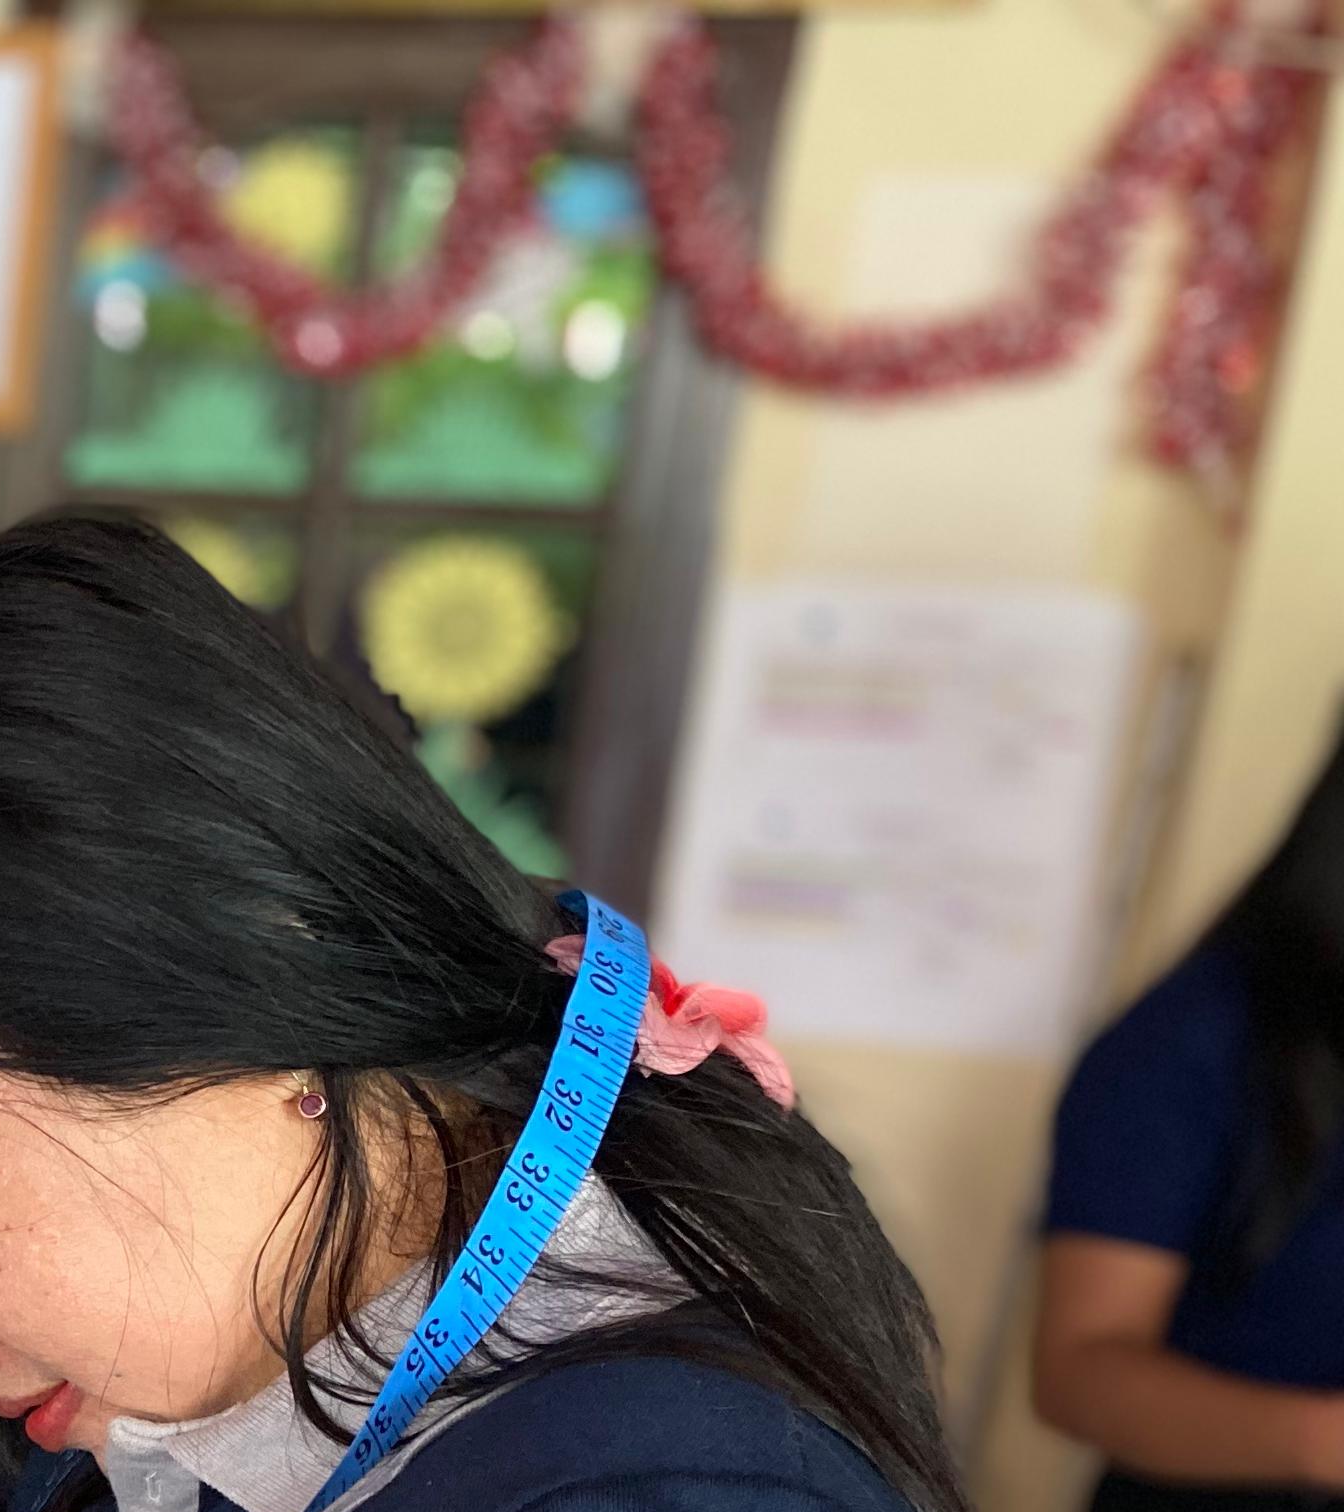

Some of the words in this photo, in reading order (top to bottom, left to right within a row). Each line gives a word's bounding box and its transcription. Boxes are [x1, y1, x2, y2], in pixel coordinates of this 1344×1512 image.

[589, 951, 624, 996] 30
[569, 1014, 605, 1058] 31
[544, 1078, 583, 1132] 32
[506, 1152, 550, 1212] 33
[459, 1234, 505, 1296] 34
[405, 1318, 449, 1379] 35
[354, 1404, 393, 1466] 36
